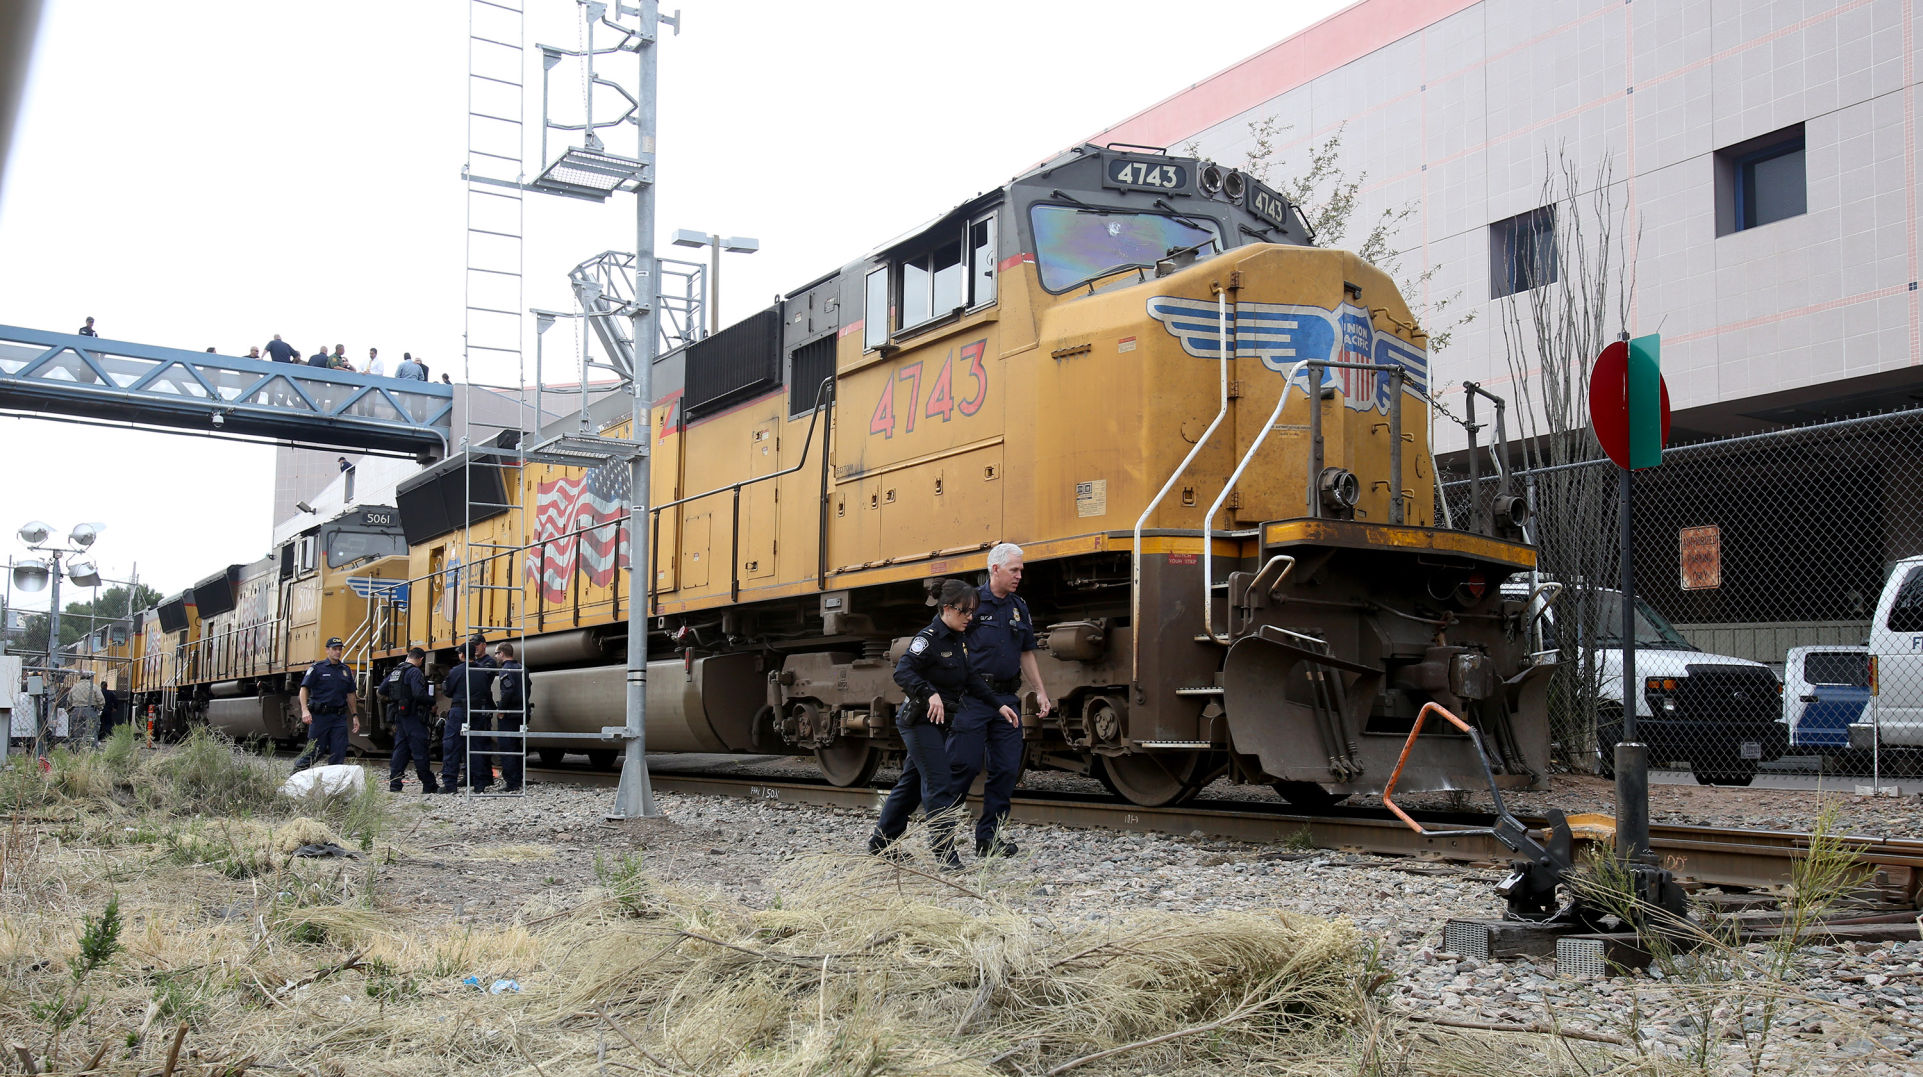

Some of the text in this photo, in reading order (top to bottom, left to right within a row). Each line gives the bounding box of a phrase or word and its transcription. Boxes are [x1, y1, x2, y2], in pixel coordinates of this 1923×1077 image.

[1117, 162, 1178, 188] 4743
[1255, 192, 1283, 223] 4743
[1343, 334, 1369, 351] ACIFIC
[869, 337, 988, 440] 4743
[367, 513, 390, 524] 5061
